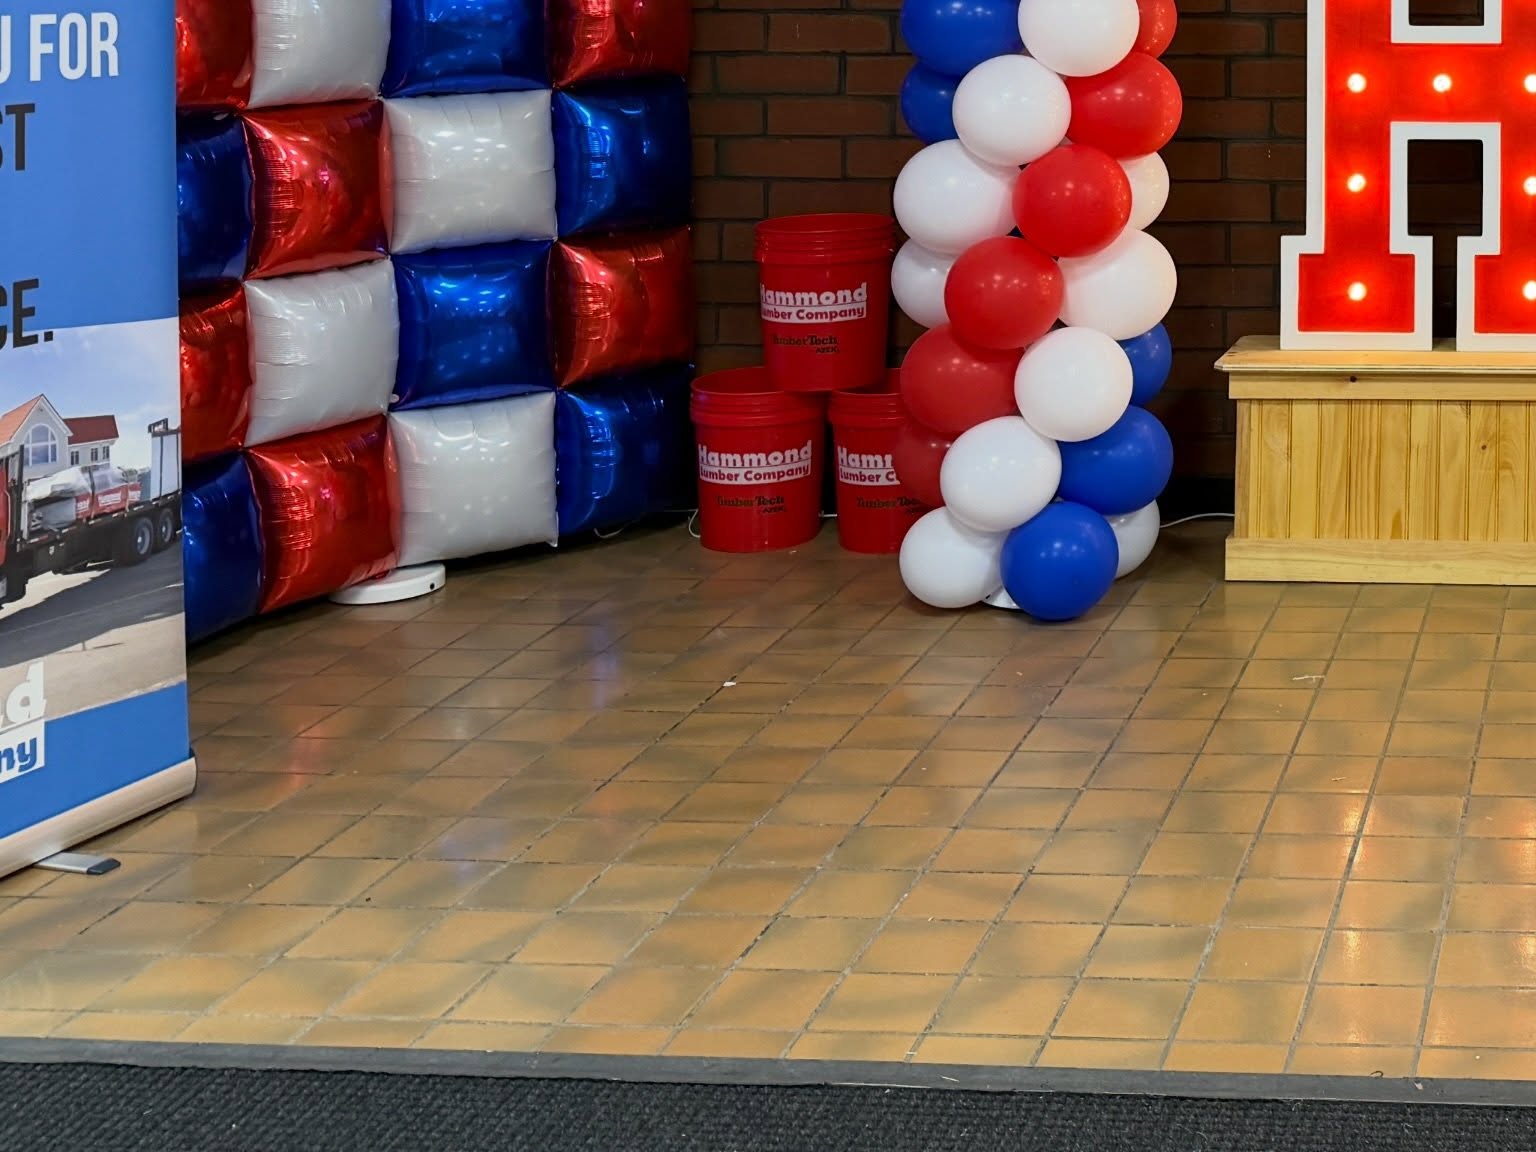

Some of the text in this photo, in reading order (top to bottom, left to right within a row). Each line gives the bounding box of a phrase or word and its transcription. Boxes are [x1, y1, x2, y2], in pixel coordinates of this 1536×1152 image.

[29, 12, 119, 82] FOR
[0, 278, 53, 348] E.
[796, 307, 864, 321] Company
[699, 440, 812, 467] Hammond
[744, 465, 810, 481] Company
